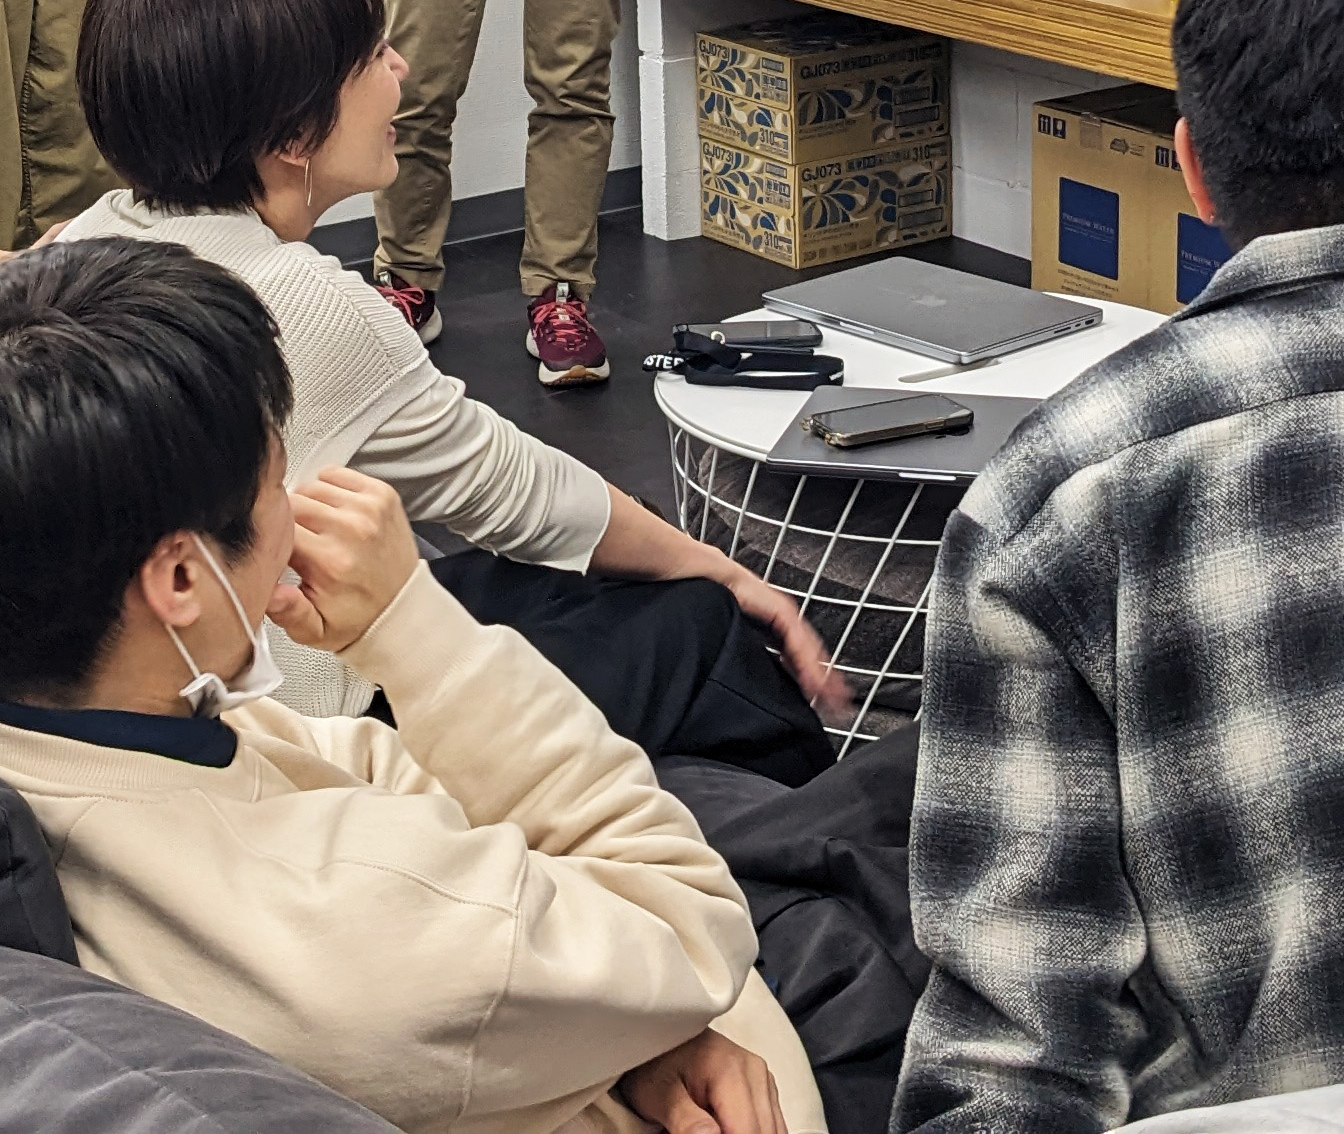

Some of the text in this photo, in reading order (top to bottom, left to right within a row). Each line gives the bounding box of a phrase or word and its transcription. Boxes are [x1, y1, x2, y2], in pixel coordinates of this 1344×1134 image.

[800, 61, 841, 79] GJ073
[759, 127, 775, 146] 310
[912, 143, 930, 162] 310
[801, 162, 842, 182] GJ073
[763, 230, 780, 249] 310
